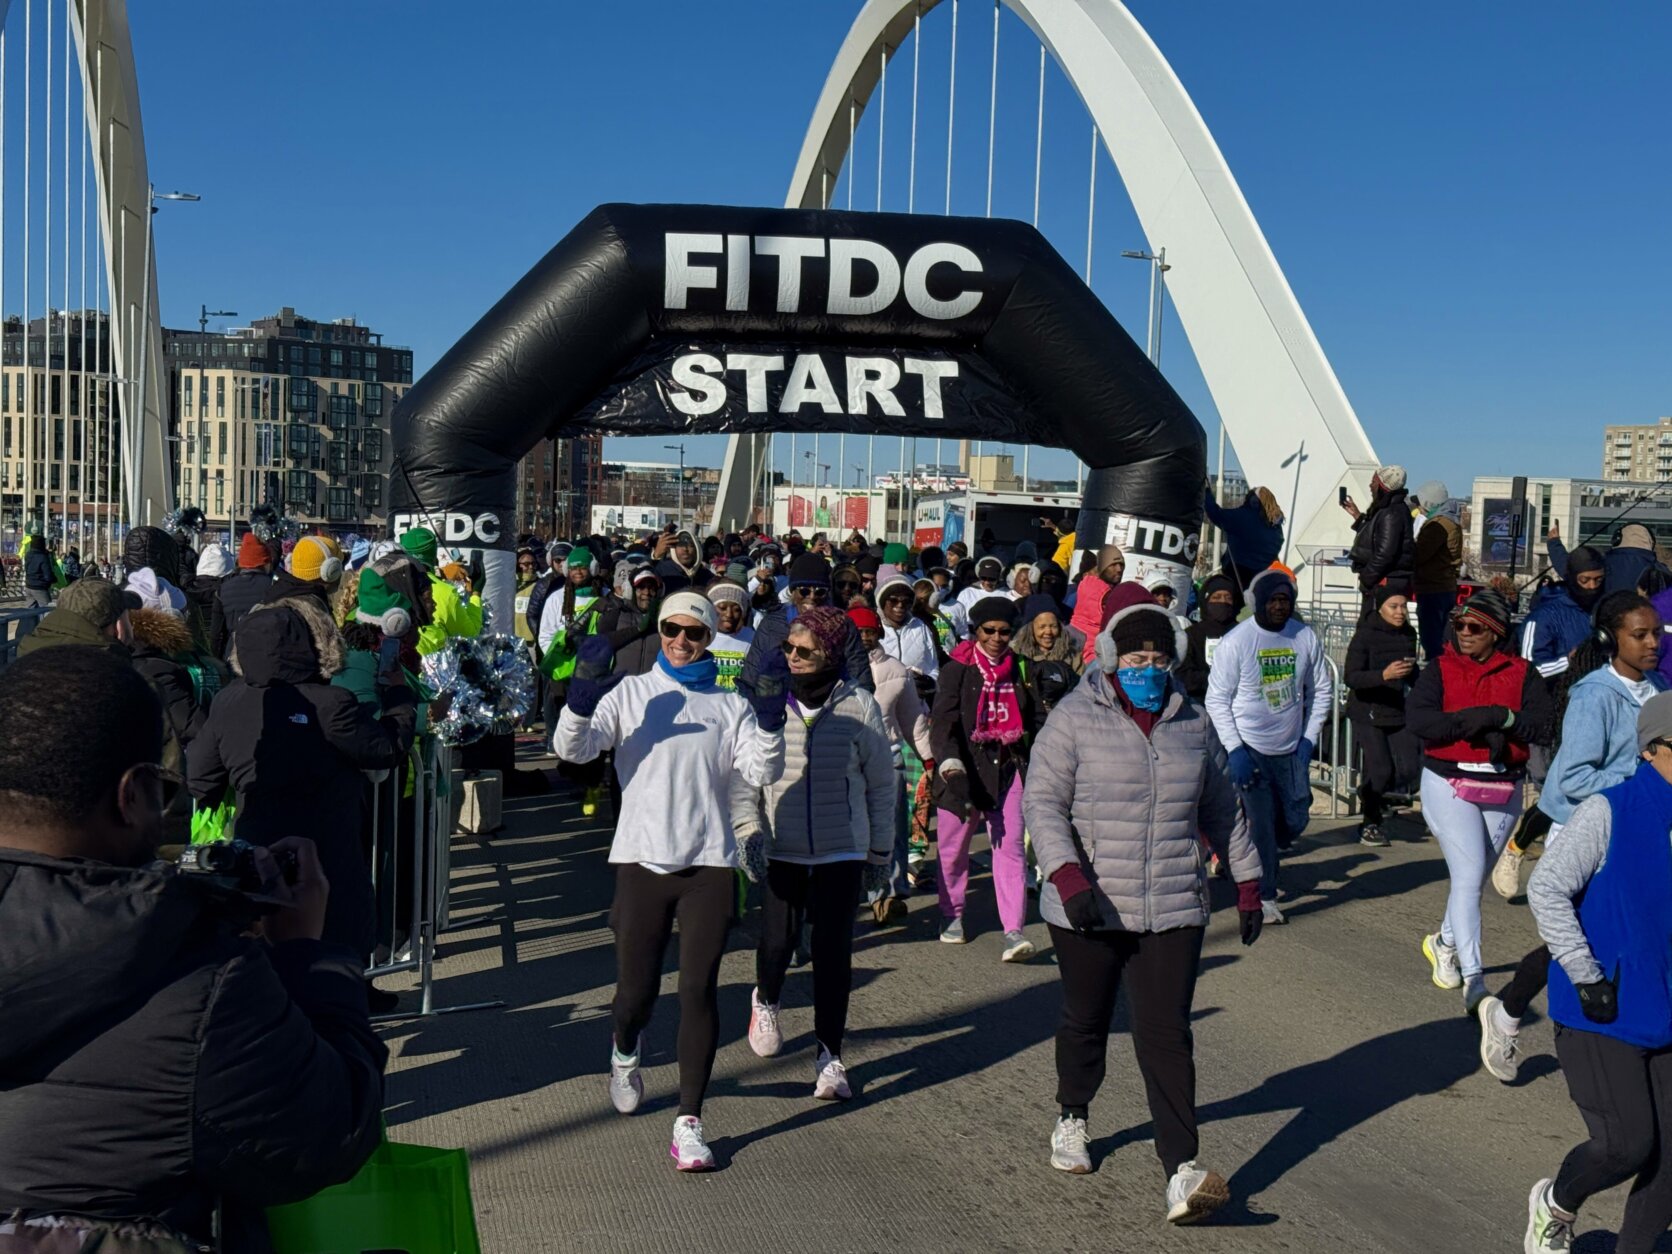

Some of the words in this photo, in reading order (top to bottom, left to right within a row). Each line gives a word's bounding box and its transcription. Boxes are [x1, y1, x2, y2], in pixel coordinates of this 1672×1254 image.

[664, 232, 984, 320] FITDC
[670, 353, 959, 419] START
[918, 507, 940, 522] U-HAUL
[1105, 515, 1199, 561] FITDC
[1262, 656, 1295, 665] FITDC
